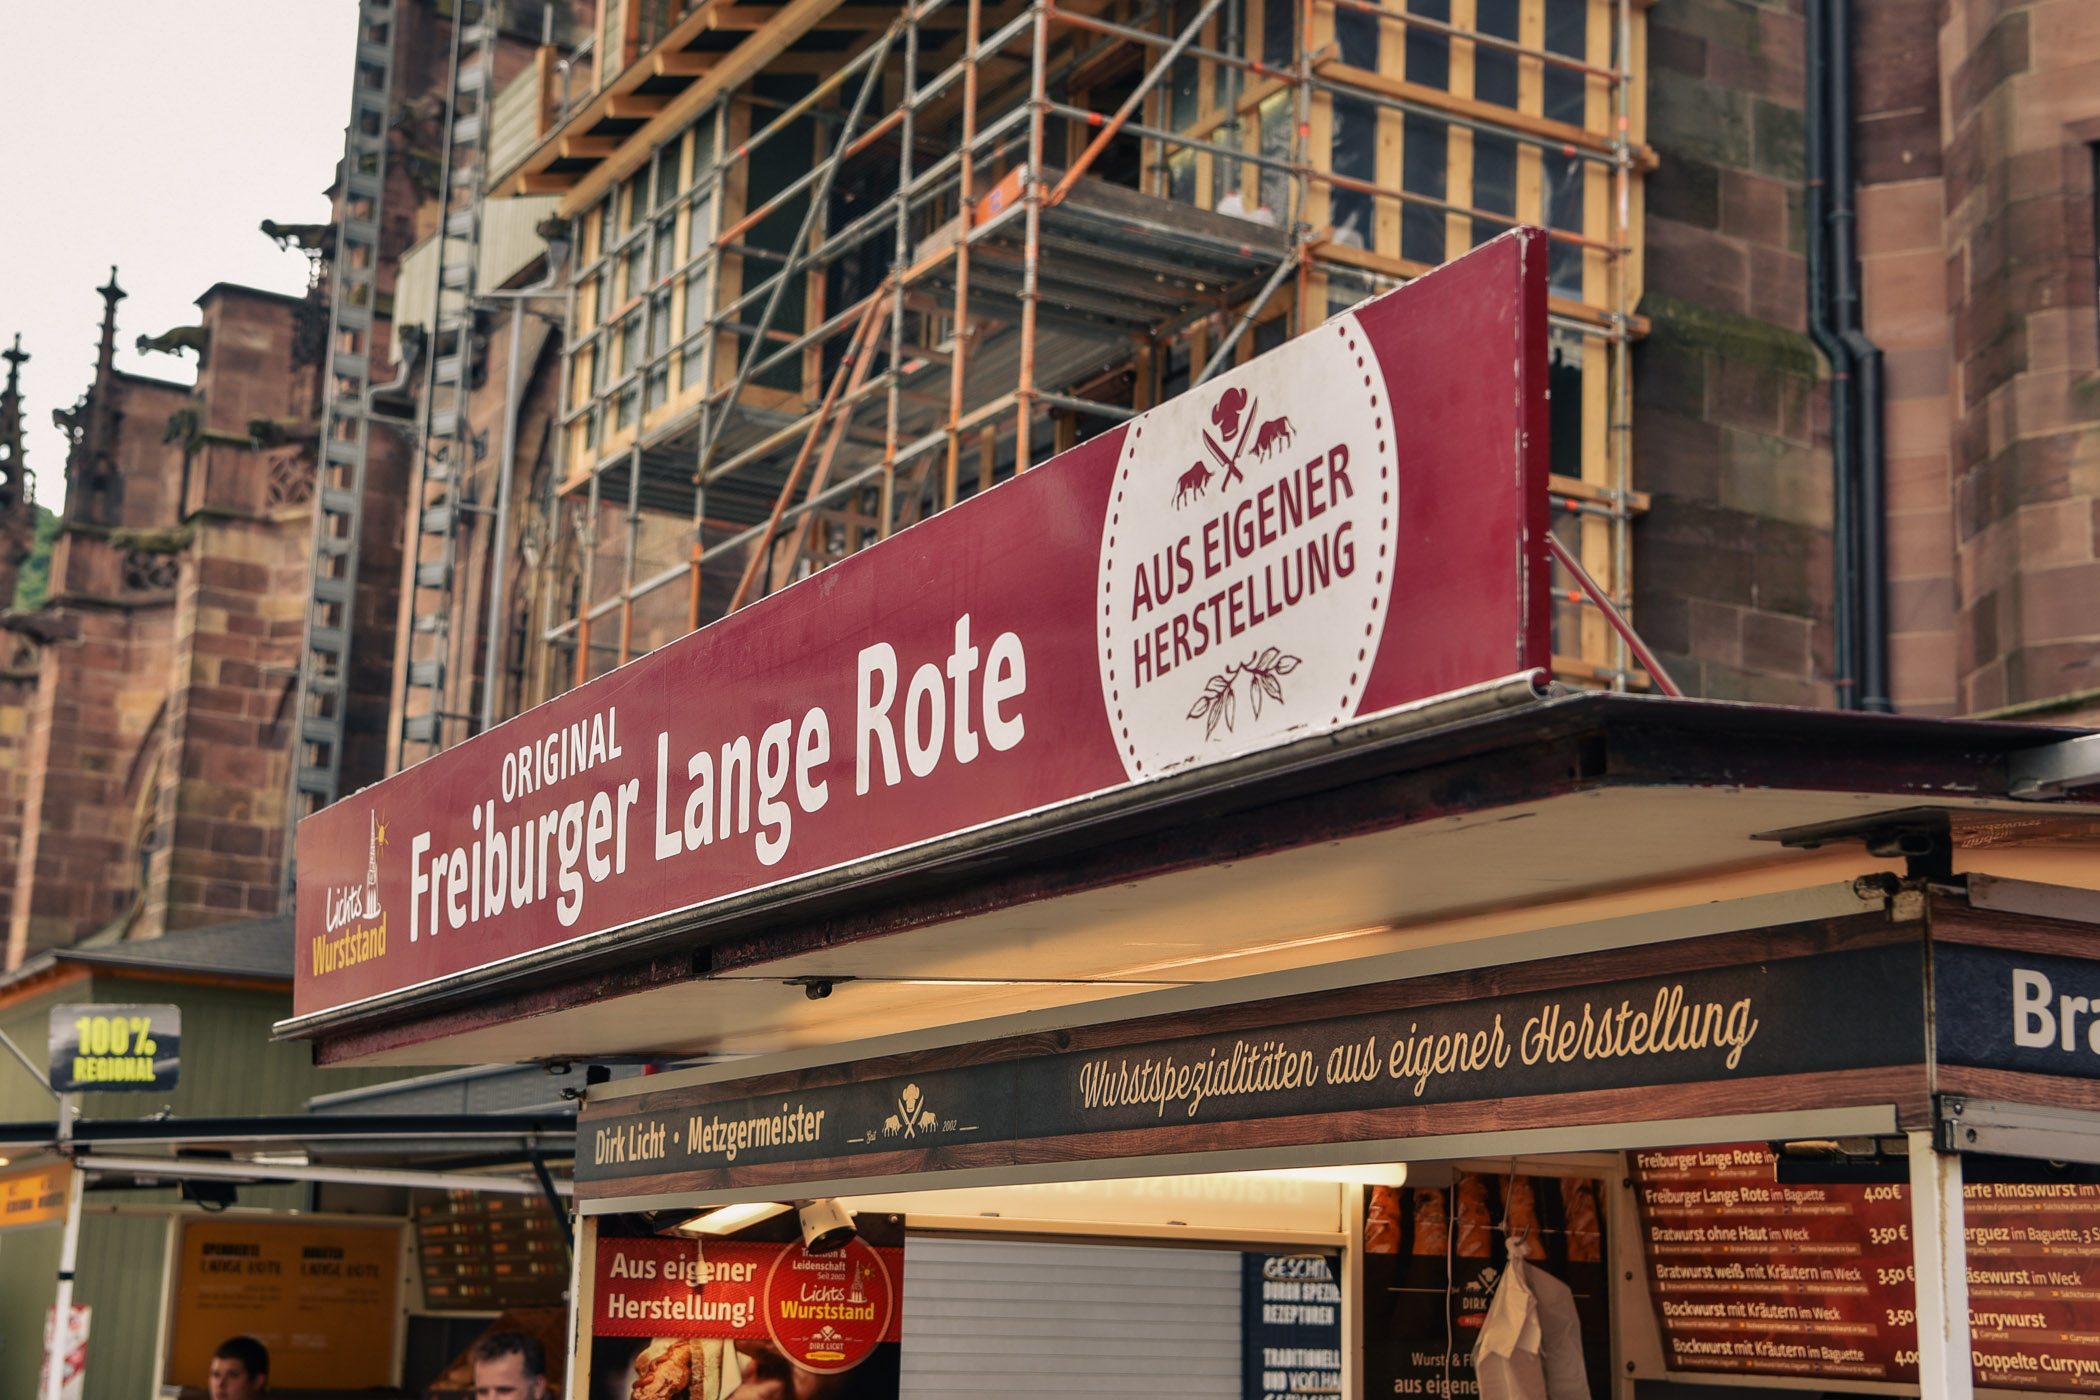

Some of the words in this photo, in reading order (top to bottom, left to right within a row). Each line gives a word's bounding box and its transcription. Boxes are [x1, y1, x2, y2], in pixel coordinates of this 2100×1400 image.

[1131, 536, 1194, 621] AUS
[1203, 443, 1355, 580] EIGENER
[1133, 520, 1356, 689] HERSTELLUNG
[502, 707, 622, 803] ORIGINAL
[410, 778, 640, 942] Freiburger
[655, 707, 831, 866] Lange
[856, 613, 1027, 797] Rote
[326, 884, 363, 933] Lichts
[312, 911, 387, 977] Wurststand
[75, 1016, 157, 1056] 100%
[1080, 1040, 1319, 1118] Wurstspezialitäten
[1327, 1035, 1382, 1085] aus
[1389, 1013, 1511, 1097] eigener
[1521, 985, 1759, 1070] Herstellung
[73, 1056, 156, 1082] REGIONAL
[595, 1125, 625, 1165] Dirk
[628, 1121, 666, 1162] Licht
[687, 1102, 825, 1161] Metzgermeister
[942, 1120, 958, 1132] 2002
[1637, 1153, 1698, 1171] Freiburger
[1699, 1151, 1732, 1171] Lange
[1733, 1150, 1763, 1165] Rote
[1645, 1188, 1702, 1208] Freiburger
[1703, 1188, 1739, 1207] Lange
[1740, 1187, 1769, 1202] Rote
[1770, 1189, 1783, 1200] im
[1784, 1189, 1826, 1205] Baguette
[1993, 1183, 2078, 1198] Rindswurst
[1651, 1226, 1705, 1242] Bratwurst
[1707, 1225, 1738, 1242] ohne
[1738, 1226, 1768, 1241] Haut
[1768, 1228, 1782, 1240] im
[1782, 1227, 1810, 1241] Weck
[2010, 1226, 2026, 1240] im
[2027, 1227, 2082, 1245] Baguette,
[2082, 1230, 2092, 1244] 3
[609, 1252, 657, 1280] Aus
[792, 1260, 846, 1271] Leidenschaft
[817, 1272, 829, 1280] Seit
[1656, 1264, 1714, 1279] Bratwurst
[1714, 1263, 1745, 1280] weiß
[1745, 1264, 1767, 1279] mit
[1766, 1263, 1819, 1280] Kräutern
[1820, 1267, 1833, 1280] im
[1833, 1267, 1862, 1281] Weck
[2031, 1271, 2047, 1284] im
[2047, 1271, 2082, 1286] Weck
[800, 1282, 845, 1302] Lichts
[608, 1293, 755, 1328] Herstellung!
[780, 1300, 875, 1320] Wurststand
[1462, 1297, 1487, 1310] DIRK
[1663, 1300, 1726, 1317] Bockwurst
[1727, 1301, 1747, 1318] mit
[1747, 1302, 1799, 1319] Kräutern
[1799, 1306, 1812, 1319] im
[1812, 1307, 1841, 1320] Weck
[1452, 1353, 1461, 1367] &
[1673, 1337, 1733, 1355] Bockwurst
[1734, 1339, 1755, 1356] mit
[1754, 1341, 1806, 1358] Kräutern
[1807, 1345, 1821, 1358] im
[1821, 1346, 1865, 1364] Baguette
[1972, 1351, 2038, 1373] Doppelte
[1394, 1379, 1422, 1394] aus
